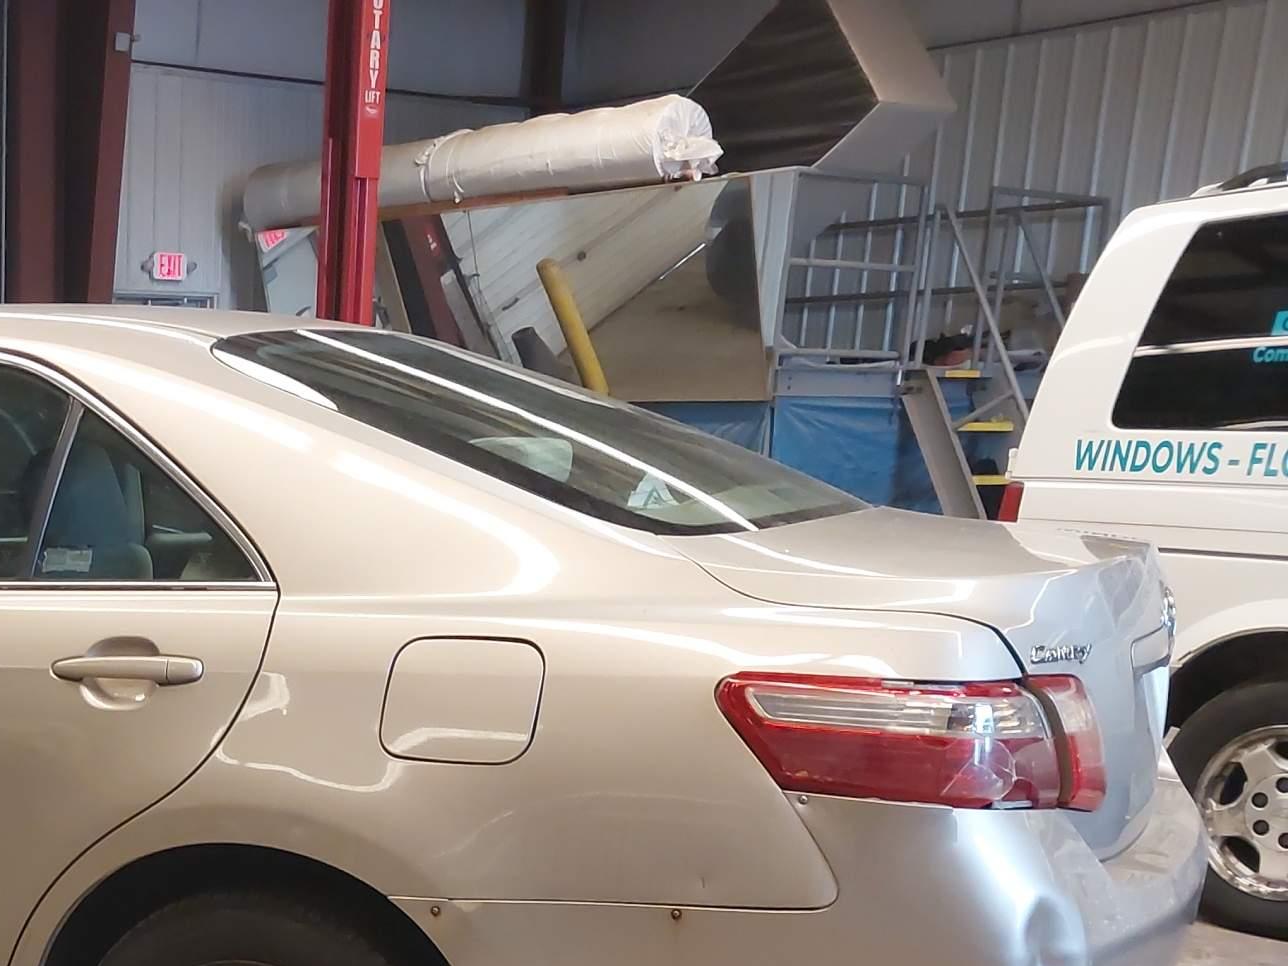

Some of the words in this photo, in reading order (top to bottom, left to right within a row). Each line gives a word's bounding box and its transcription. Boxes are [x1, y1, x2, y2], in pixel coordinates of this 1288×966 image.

[365, 90, 381, 104] LIFT
[159, 254, 183, 277] EXIT
[1075, 439, 1223, 475] WINDOWS
